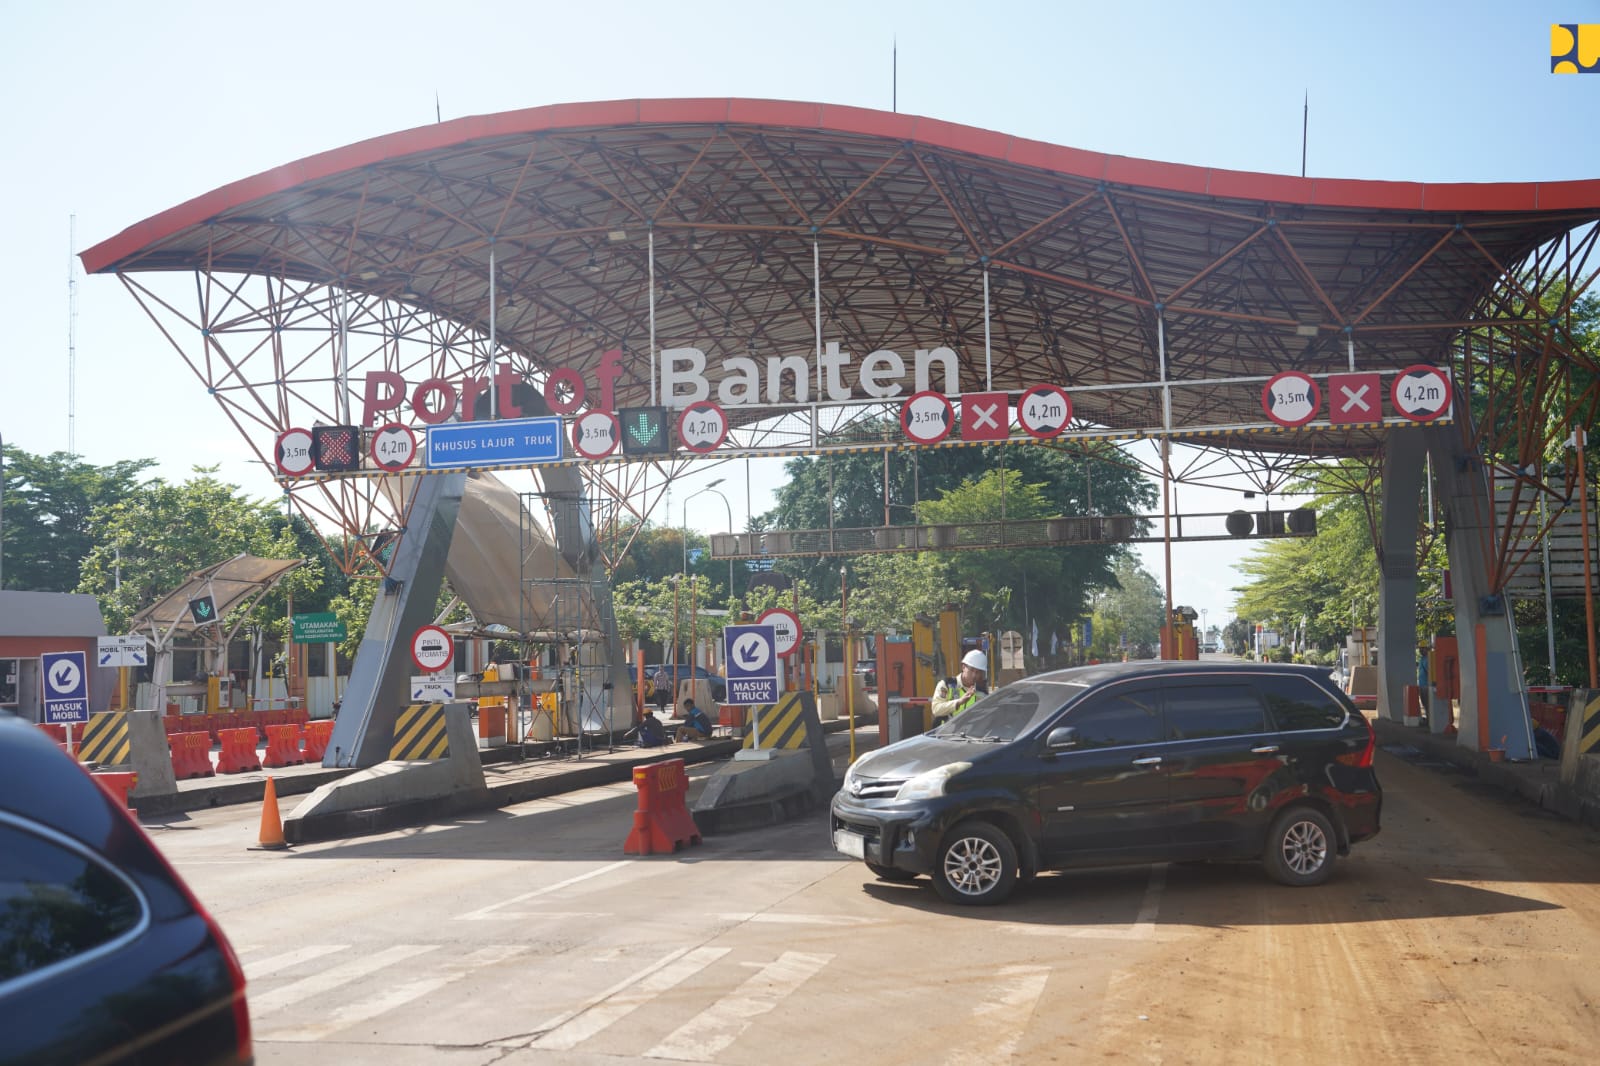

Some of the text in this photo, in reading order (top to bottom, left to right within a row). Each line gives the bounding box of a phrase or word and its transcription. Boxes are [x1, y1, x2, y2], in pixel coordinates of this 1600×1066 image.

[362, 341, 960, 427] Port of Banten
[1278, 392, 1305, 405] 3,5m
[1404, 385, 1439, 403] 4,2m
[915, 411, 941, 424] 3,5m
[1029, 404, 1061, 420] 4,2m
[585, 427, 608, 439] 3,5m
[688, 420, 718, 436] 4,2m
[381, 440, 407, 454] 4,2m
[434, 434, 553, 452] KHUSUS LAJUR TRUK
[286, 446, 307, 458] 3,5m
[300, 621, 338, 629] UTAMAKAN
[733, 682, 771, 692] MASUK
[734, 691, 770, 701] TRUCK
[50, 702, 82, 712] MASUK
[52, 711, 81, 720] MOBIL
